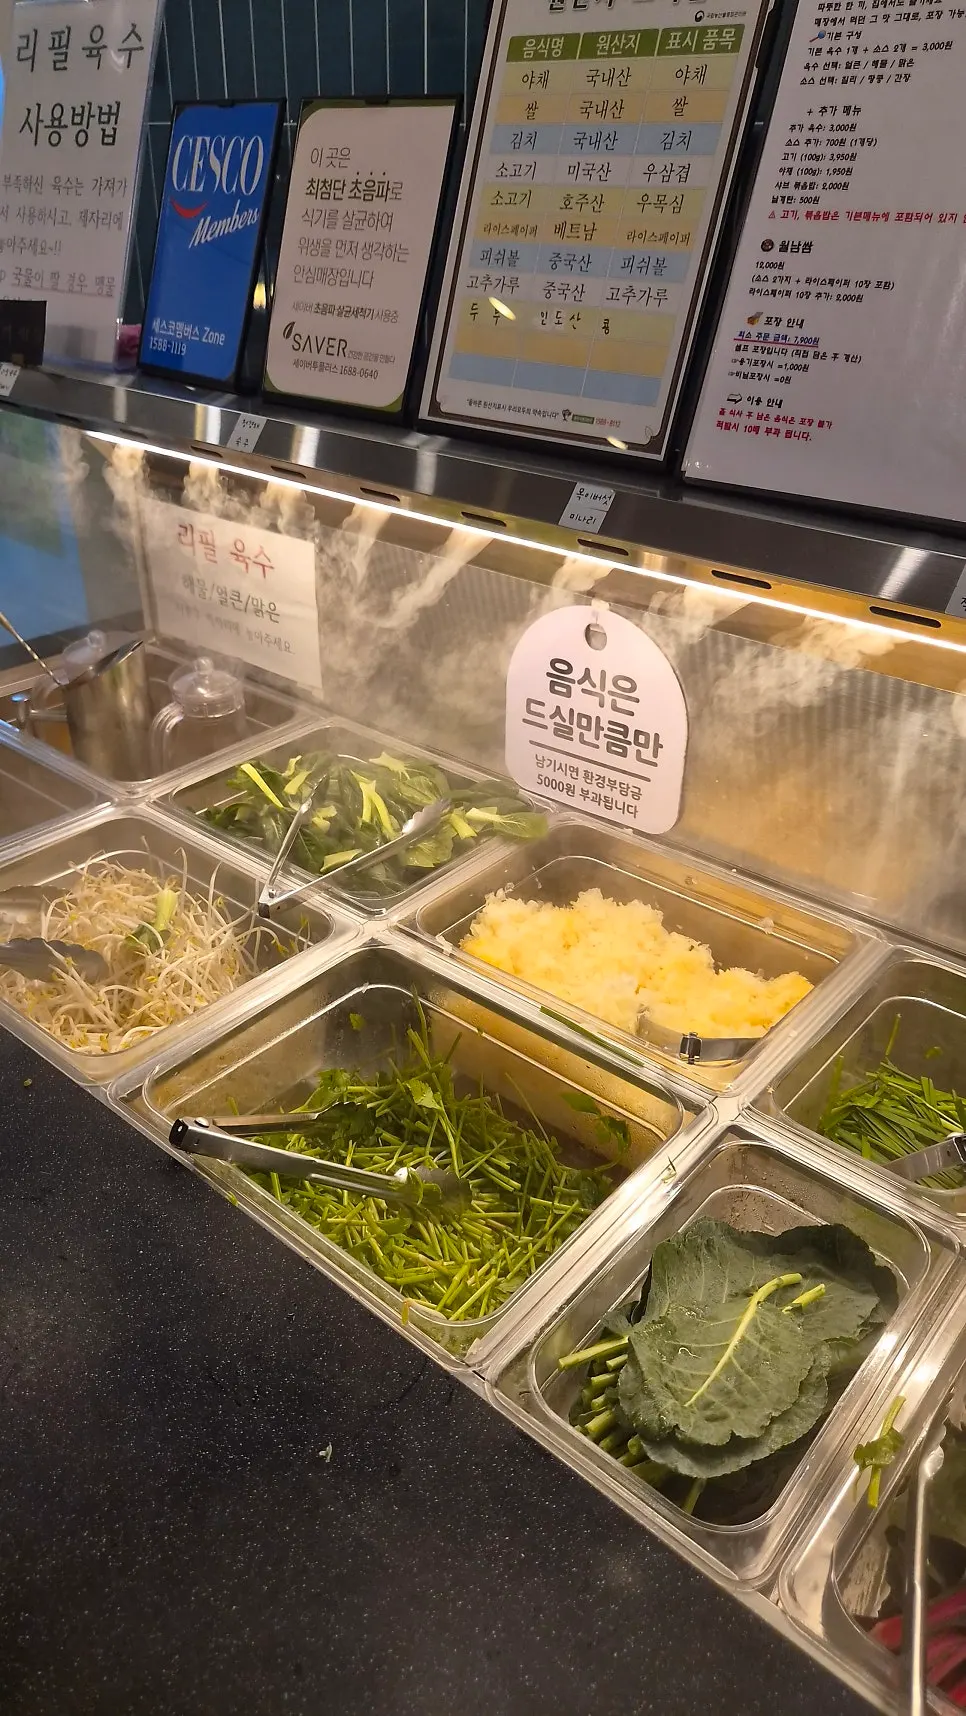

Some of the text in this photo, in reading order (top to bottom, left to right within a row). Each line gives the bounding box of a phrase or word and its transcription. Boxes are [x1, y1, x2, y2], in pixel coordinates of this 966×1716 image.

[814, 11, 943, 26] 매장에서 먹던 그 맛 그대로, 포장
[523, 28, 736, 58] 음식명 원산지 표시 품목
[826, 31, 862, 41] 기본 구성
[808, 41, 953, 56] 기본 육수 1개 소스 2개 3,000원
[804, 58, 914, 71] 육수 선택: 얼큰 해물 맑은
[522, 64, 708, 89] 야채 국내산 야채
[800, 74, 911, 85] 소스 선택: 칠리 땅콩 간장
[525, 96, 688, 120] 쌀 국내산 쌀
[818, 105, 862, 116] 추가 메뉴
[20, 101, 121, 147] 사용방법
[789, 123, 857, 132] 추가 육수: 3,000원
[511, 130, 693, 151] 김치 국내산 김치
[804, 138, 822, 147] 추가:
[826, 138, 846, 147] 700원
[850, 138, 878, 147] (1개당)
[172, 135, 264, 196] CESCO
[311, 147, 350, 168] 이 곳은
[781, 153, 857, 162] 고기 (100g): 3,950원
[496, 161, 691, 183] 소고기 미국산 우삼겹
[797, 167, 853, 176] (100g): 1,950원
[3, 175, 128, 198] 부족하신 육수는 가져가
[306, 178, 403, 202] 최첨단 초음파로
[822, 182, 849, 190] 2,000원
[490, 189, 686, 213] 소고기 호주산 우목심
[799, 196, 820, 204] 500원
[79, 209, 124, 230] 제자리에
[188, 199, 260, 249] Members
[302, 208, 394, 232] 식기를 살균하여
[780, 210, 799, 220] 고기,
[805, 211, 840, 221] 볶음밥은
[846, 211, 890, 221] 기본메뉴에
[895, 212, 933, 223] 포함되어
[938, 213, 957, 223] 있지
[483, 221, 691, 246] 라이스페이퍼 베트남 라이스페이퍼
[298, 237, 409, 263] 위생을 먼저 생각하는
[779, 240, 813, 253] 월남쌈
[480, 248, 668, 276] 피쉬볼 중국산 피쉬볼
[756, 262, 784, 270] 12,000원
[13, 266, 44, 288] 국물이
[294, 264, 374, 288] 안심매장입니다
[752, 274, 895, 290] (소스 2가지 라이스페이퍼 10장 포함)
[467, 274, 669, 307] 고추가루 중국산 고추가루
[749, 288, 863, 302] 라이스페이퍼 10장 추가: 2,000원
[314, 302, 398, 323] 초음파 살균세척기 사용중
[764, 316, 805, 329] 포장 안내
[152, 317, 225, 346] 세스코멤버스 Zone
[602, 319, 610, 335] 콩
[150, 336, 186, 355] 1588-1119
[292, 333, 348, 357] SAVER
[756, 332, 770, 341] 주문
[794, 336, 819, 345] 7,900원
[752, 346, 862, 363] 포장입니다 (직접 담은 계산)
[340, 365, 378, 379] 1688-0640
[738, 358, 809, 372] 용기포장시 =1,000원
[735, 371, 770, 382] 비닐포장시
[747, 396, 783, 408] 이용 안내
[729, 409, 743, 418] 식사
[757, 412, 770, 421] 남은
[774, 415, 796, 424] 음식은
[799, 418, 814, 426] 포장
[716, 421, 812, 441] 적발시 10배 부과 됩니다.
[570, 513, 596, 524] 미나리
[177, 523, 275, 579] 리필 육수
[546, 658, 640, 716] 음식은
[522, 698, 663, 767] 드실만큼만
[535, 754, 642, 801] 남기시면 환경부담금
[537, 773, 638, 819] 5000원 부과됩니다
